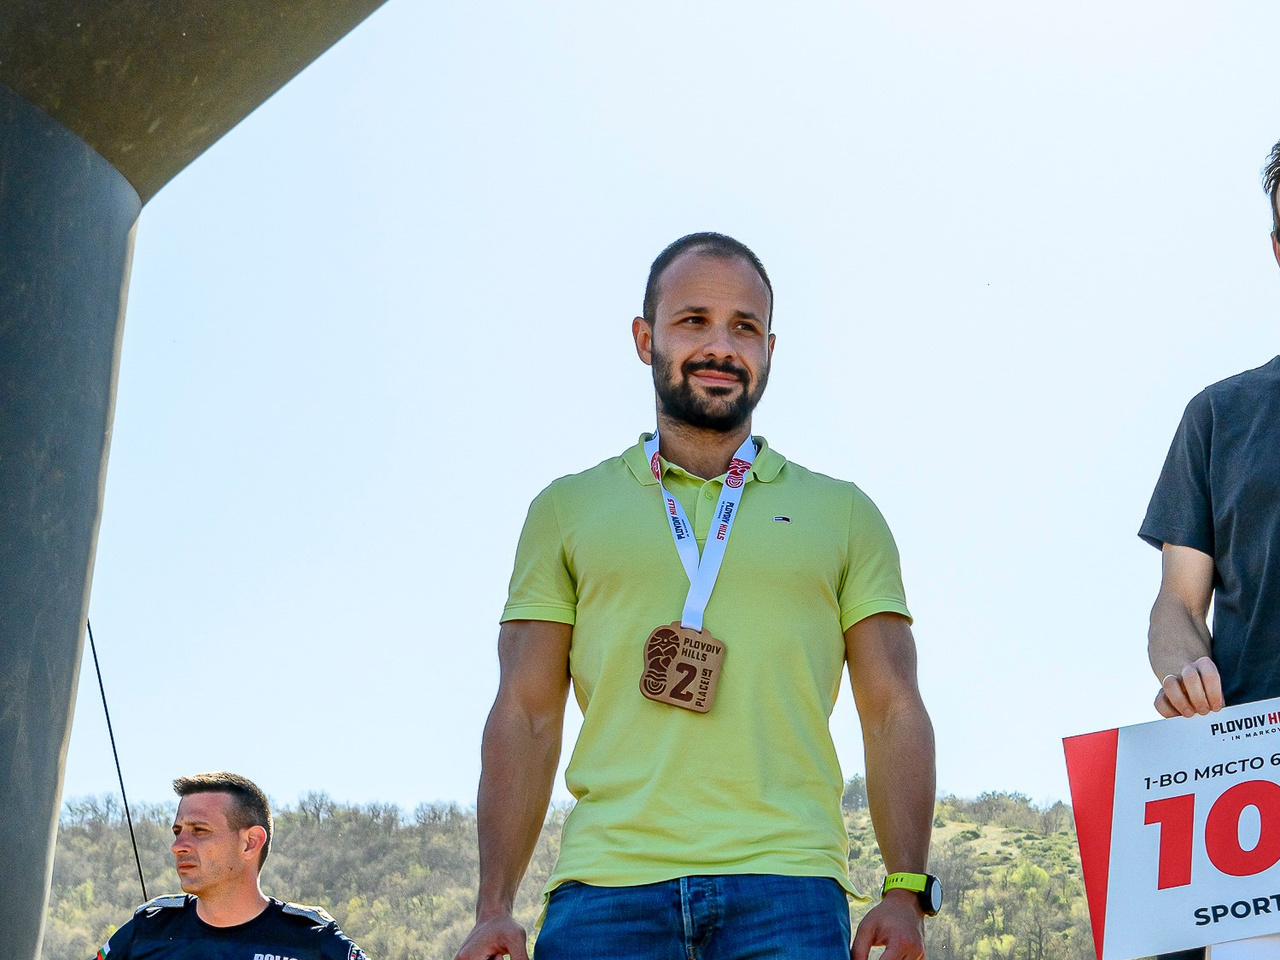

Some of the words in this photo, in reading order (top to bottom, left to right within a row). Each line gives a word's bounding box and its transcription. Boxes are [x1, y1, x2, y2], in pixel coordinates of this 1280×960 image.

[681, 647, 708, 662] HILLS
[683, 637, 722, 655] PLOVDIV
[669, 662, 698, 702] 2
[701, 668, 713, 678] ST
[695, 679, 711, 708] PLACE
[1210, 713, 1266, 736] PLOVDIV
[1143, 771, 1188, 790] 1-ВО
[1194, 756, 1265, 781] МЯСТО
